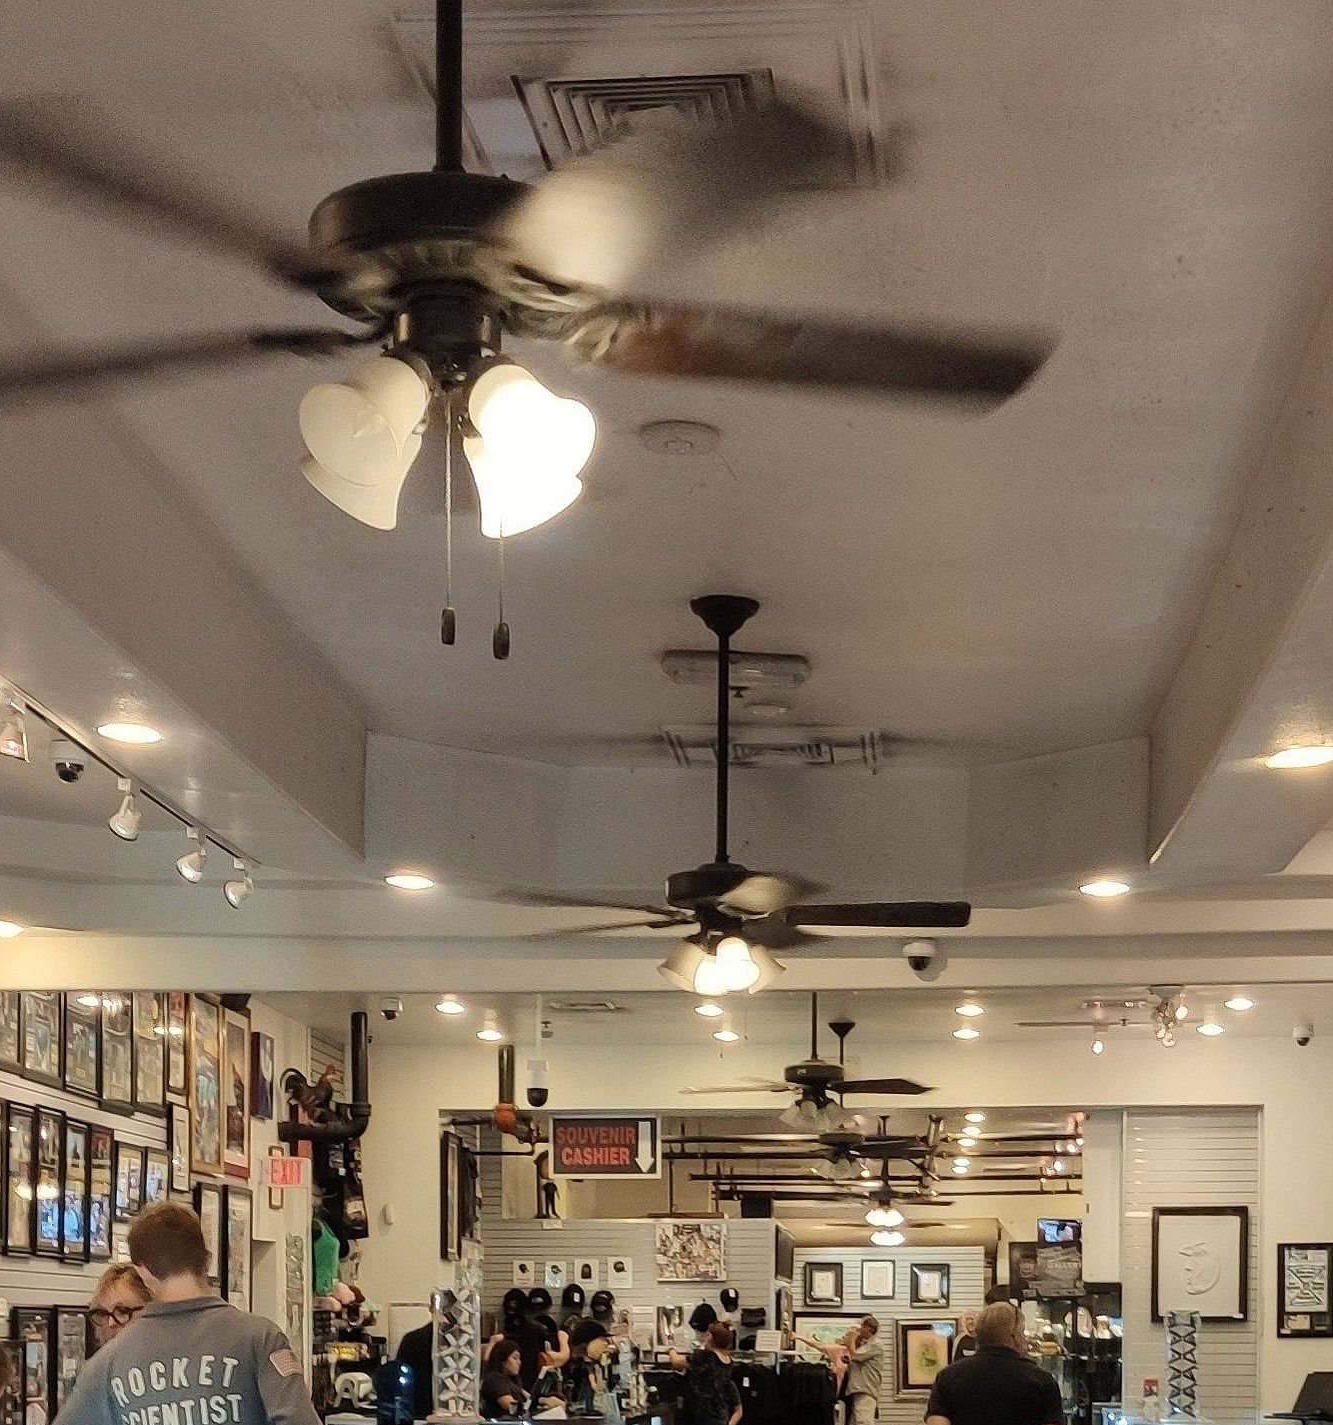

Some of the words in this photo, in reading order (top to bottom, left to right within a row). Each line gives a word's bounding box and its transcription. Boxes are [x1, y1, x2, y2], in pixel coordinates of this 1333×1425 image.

[555, 1126, 635, 1144] SOUVENIR
[561, 1147, 630, 1166] CASHIER
[270, 1159, 301, 1184] EXIT
[111, 1355, 239, 1408] ROCKET
